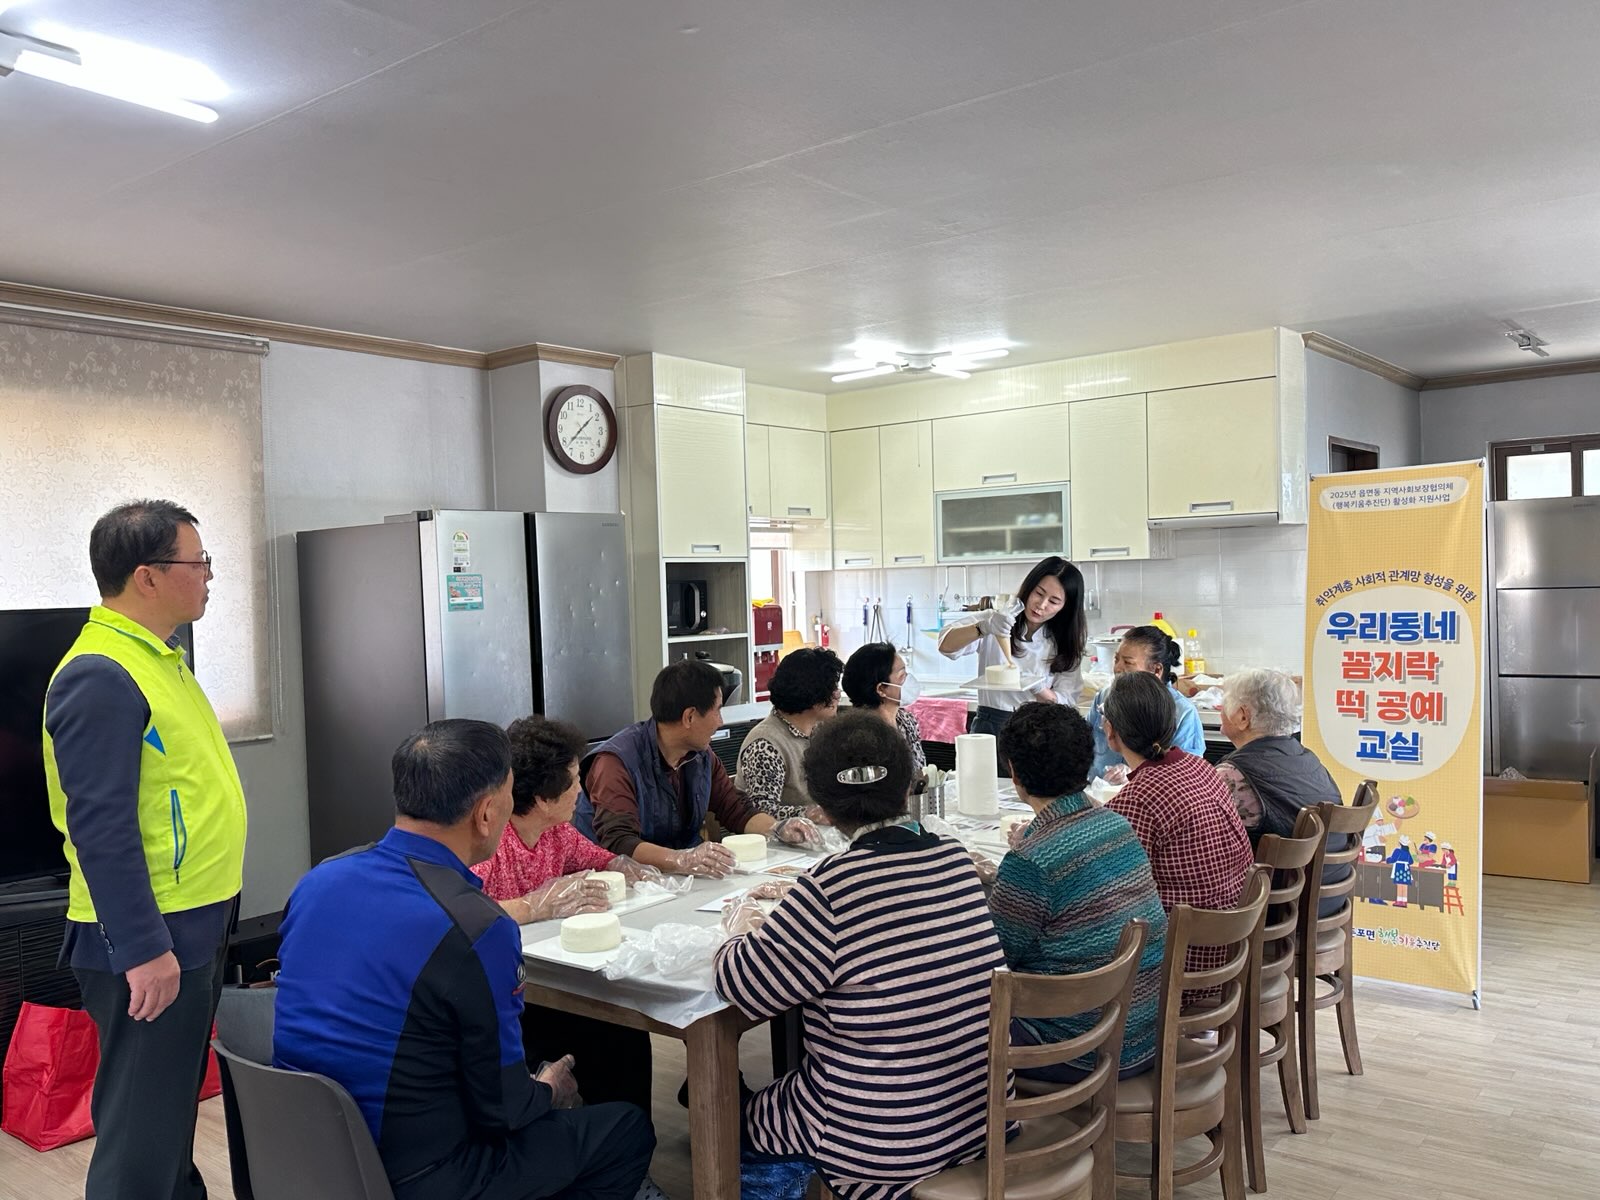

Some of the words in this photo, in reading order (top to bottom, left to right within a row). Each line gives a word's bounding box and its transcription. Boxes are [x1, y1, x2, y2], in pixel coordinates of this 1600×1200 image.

[567, 402, 573, 411] 11
[577, 399, 584, 407] 12
[560, 411, 567, 419] 10
[595, 413, 599, 421] 2
[558, 424, 563, 433] 9
[598, 427, 603, 435] 3
[562, 437, 567, 446] 8
[596, 439, 600, 447] 4
[569, 448, 573, 456] 7
[580, 451, 584, 460] 6
[590, 448, 595, 457] 5
[1330, 489, 1356, 499] 2025년
[1358, 487, 1380, 497] 읍면동
[1384, 482, 1453, 495] 지역사회보장협의체
[1332, 498, 1391, 510] (행복키움추진단)
[1393, 496, 1416, 505] 활성화
[1419, 493, 1450, 504] 지원사업
[1315, 579, 1354, 607] 취약계층
[1355, 571, 1386, 587] 사회적
[1389, 569, 1421, 583] 관계망
[1423, 572, 1455, 592] 형성을
[1455, 583, 1477, 604] 위한
[1326, 610, 1457, 642] 우리동네
[1341, 651, 1440, 681] 꼼지락
[1335, 689, 1366, 719] 떡
[1376, 690, 1444, 722] 공예
[1355, 729, 1419, 761] 교실
